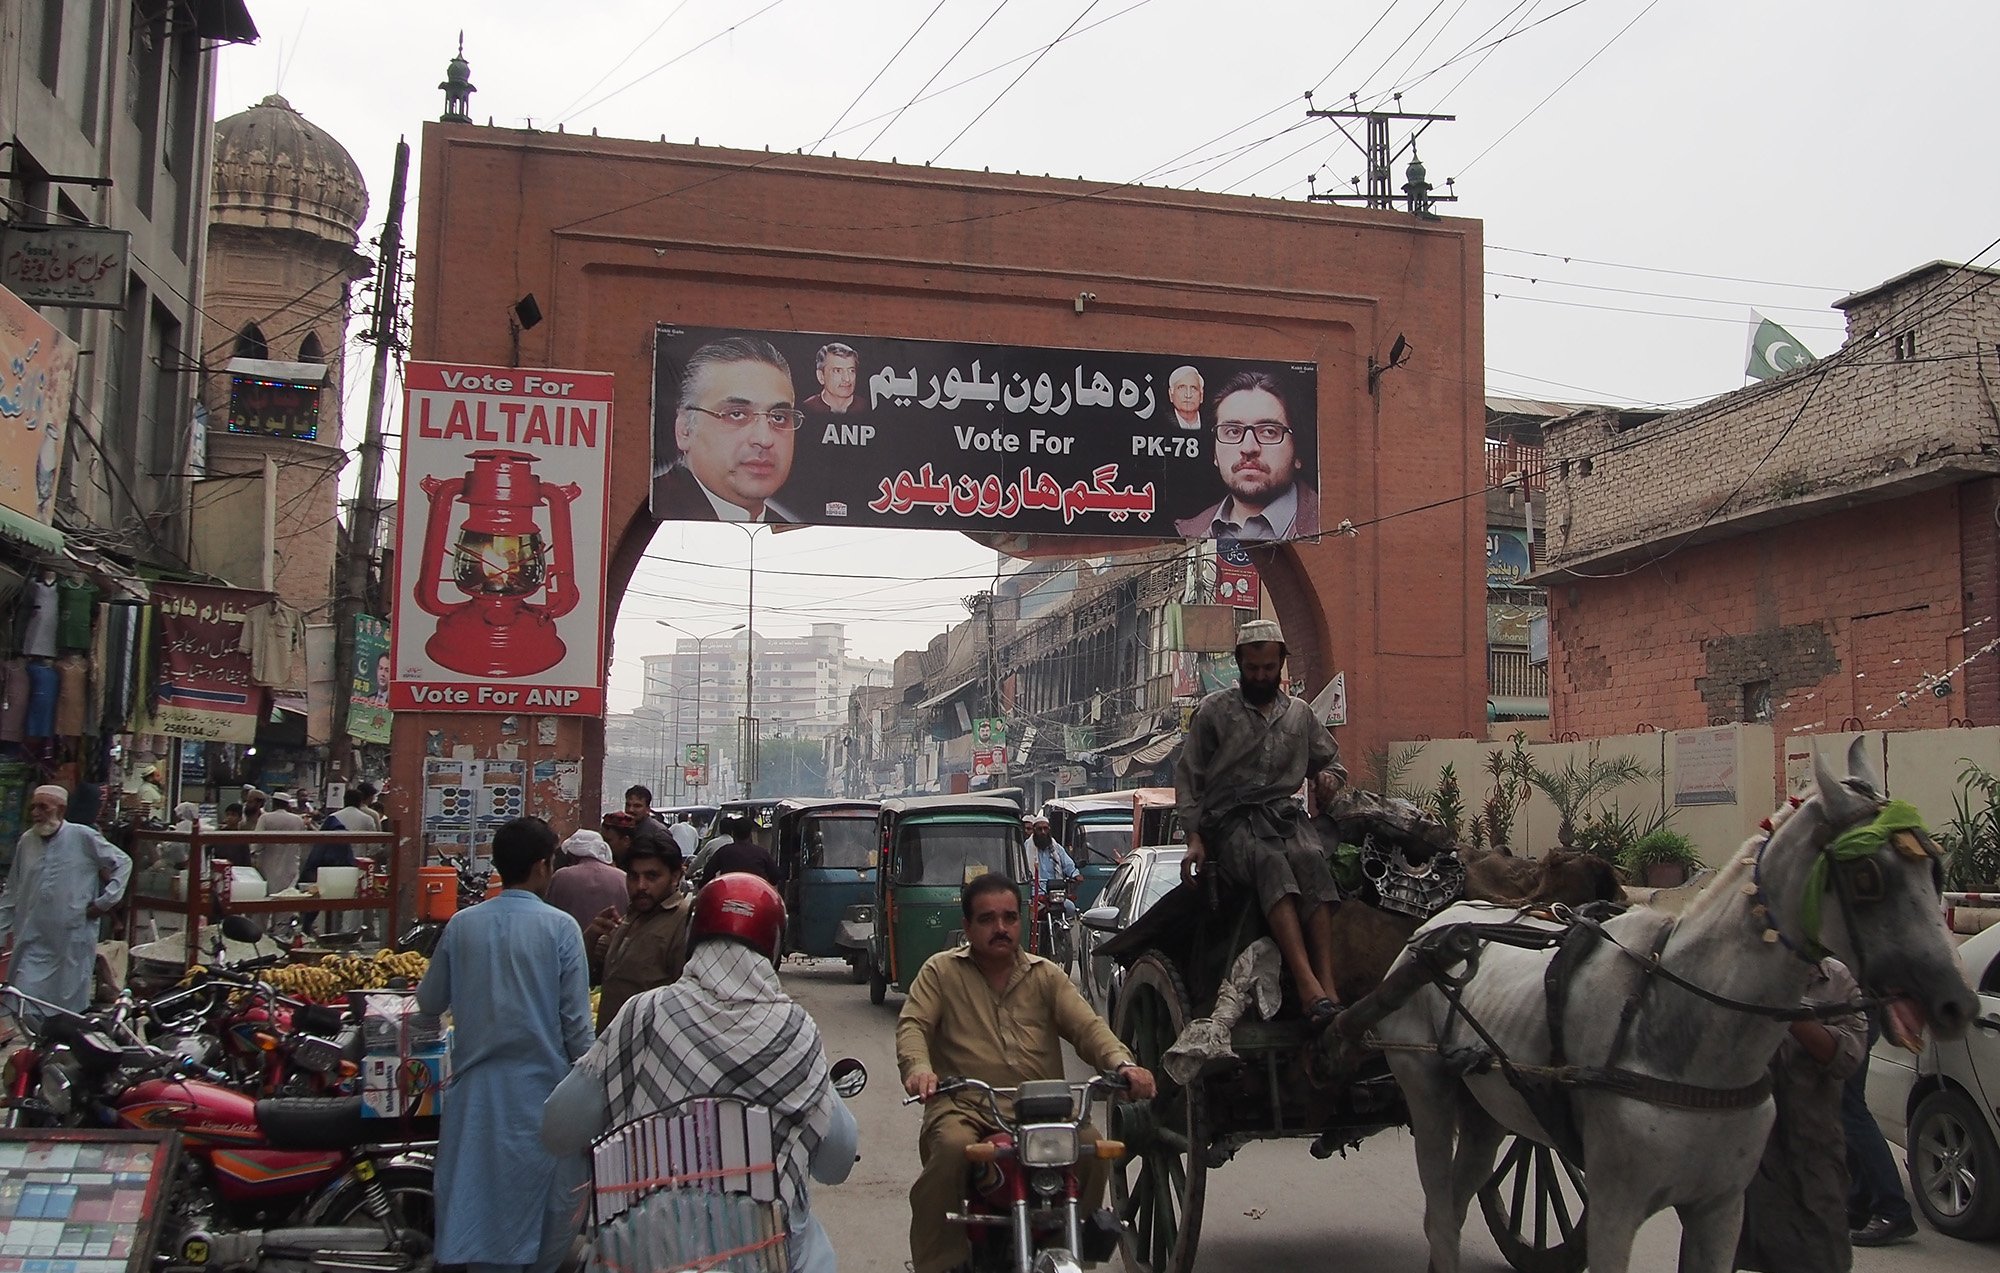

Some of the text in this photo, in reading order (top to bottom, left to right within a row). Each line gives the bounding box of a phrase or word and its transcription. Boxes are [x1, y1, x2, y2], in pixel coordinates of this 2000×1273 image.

[440, 370, 574, 397] Vote For
[418, 397, 598, 449] LALTAIN
[821, 423, 876, 446] ANP
[953, 425, 1075, 454] Vote For
[1131, 435, 1200, 458] PK-78
[868, 462, 952, 516] بلور
[410, 685, 470, 705] Vote
[477, 686, 519, 706] For
[525, 688, 580, 708] ANP
